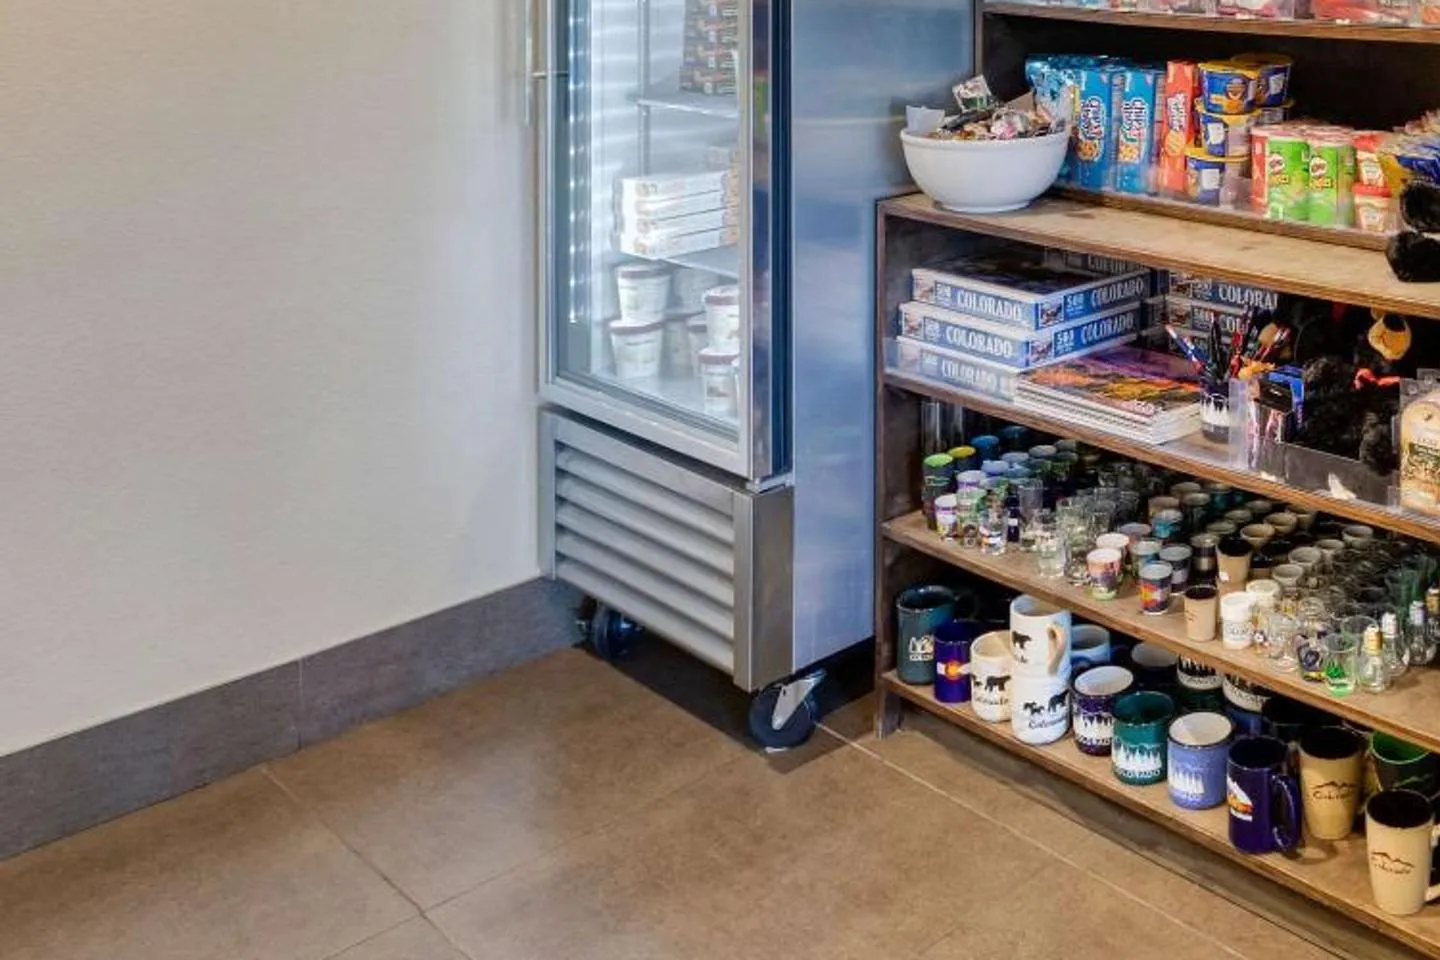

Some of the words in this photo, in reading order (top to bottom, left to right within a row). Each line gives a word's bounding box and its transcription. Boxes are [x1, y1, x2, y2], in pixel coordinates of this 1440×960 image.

[957, 289, 1023, 321] COLORADO
[1091, 276, 1145, 308] COLORADO
[1218, 282, 1279, 311] COLORA
[945, 325, 1013, 359] COLORADO
[1081, 312, 1134, 345] COLORADO
[941, 356, 998, 393] COLORADO
